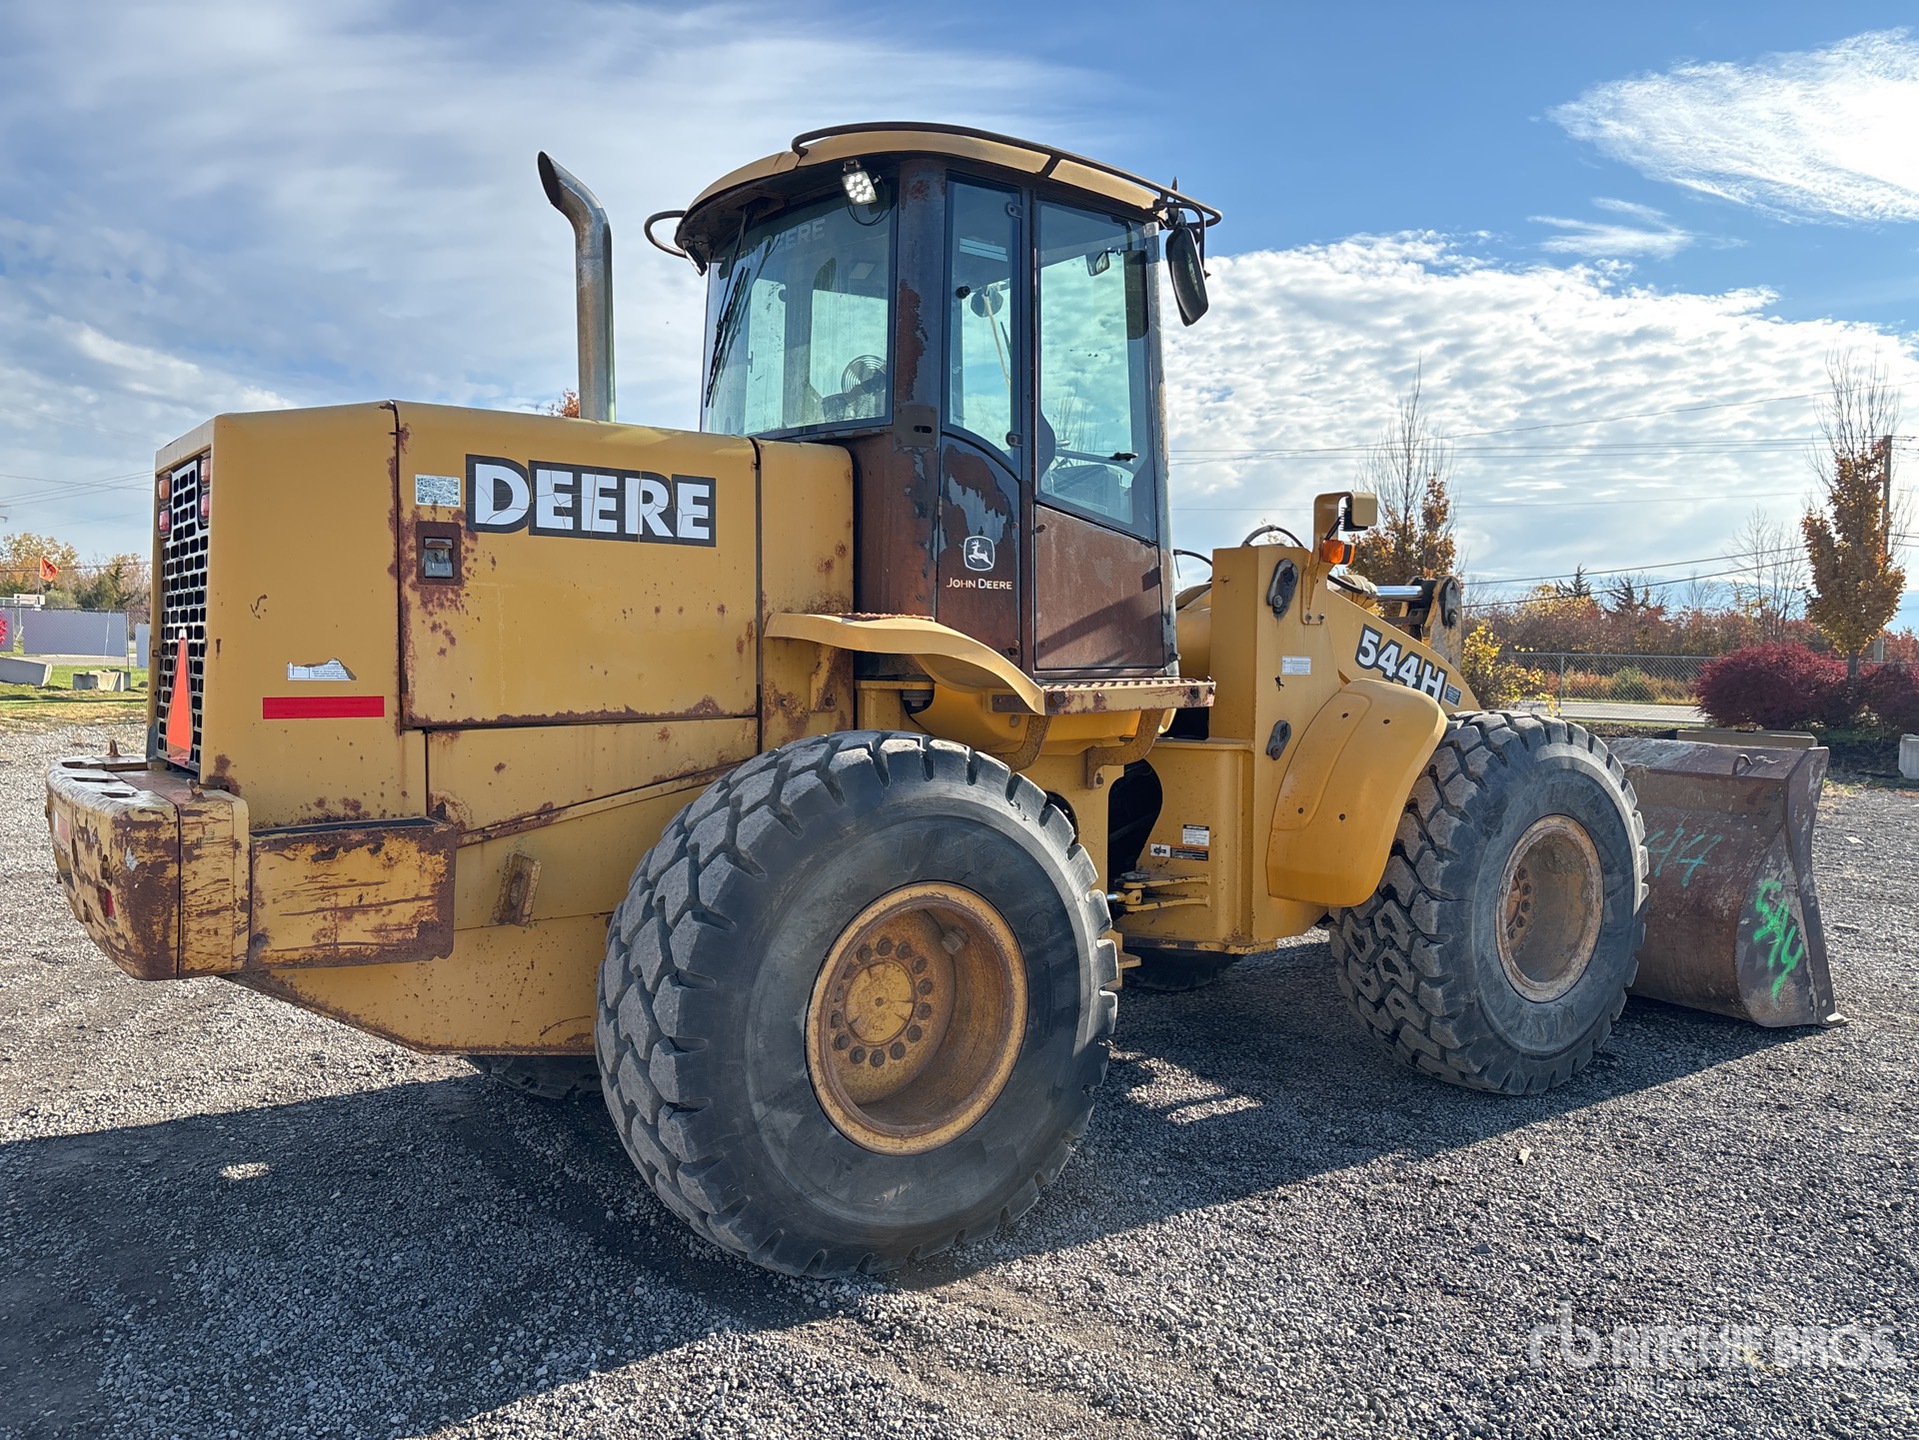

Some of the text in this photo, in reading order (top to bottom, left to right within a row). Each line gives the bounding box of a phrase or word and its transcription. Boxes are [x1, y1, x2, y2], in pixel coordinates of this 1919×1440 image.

[474, 462, 711, 541] DEERE
[946, 577, 1013, 590] JOHN DEERE
[1357, 627, 1446, 704] 544H
